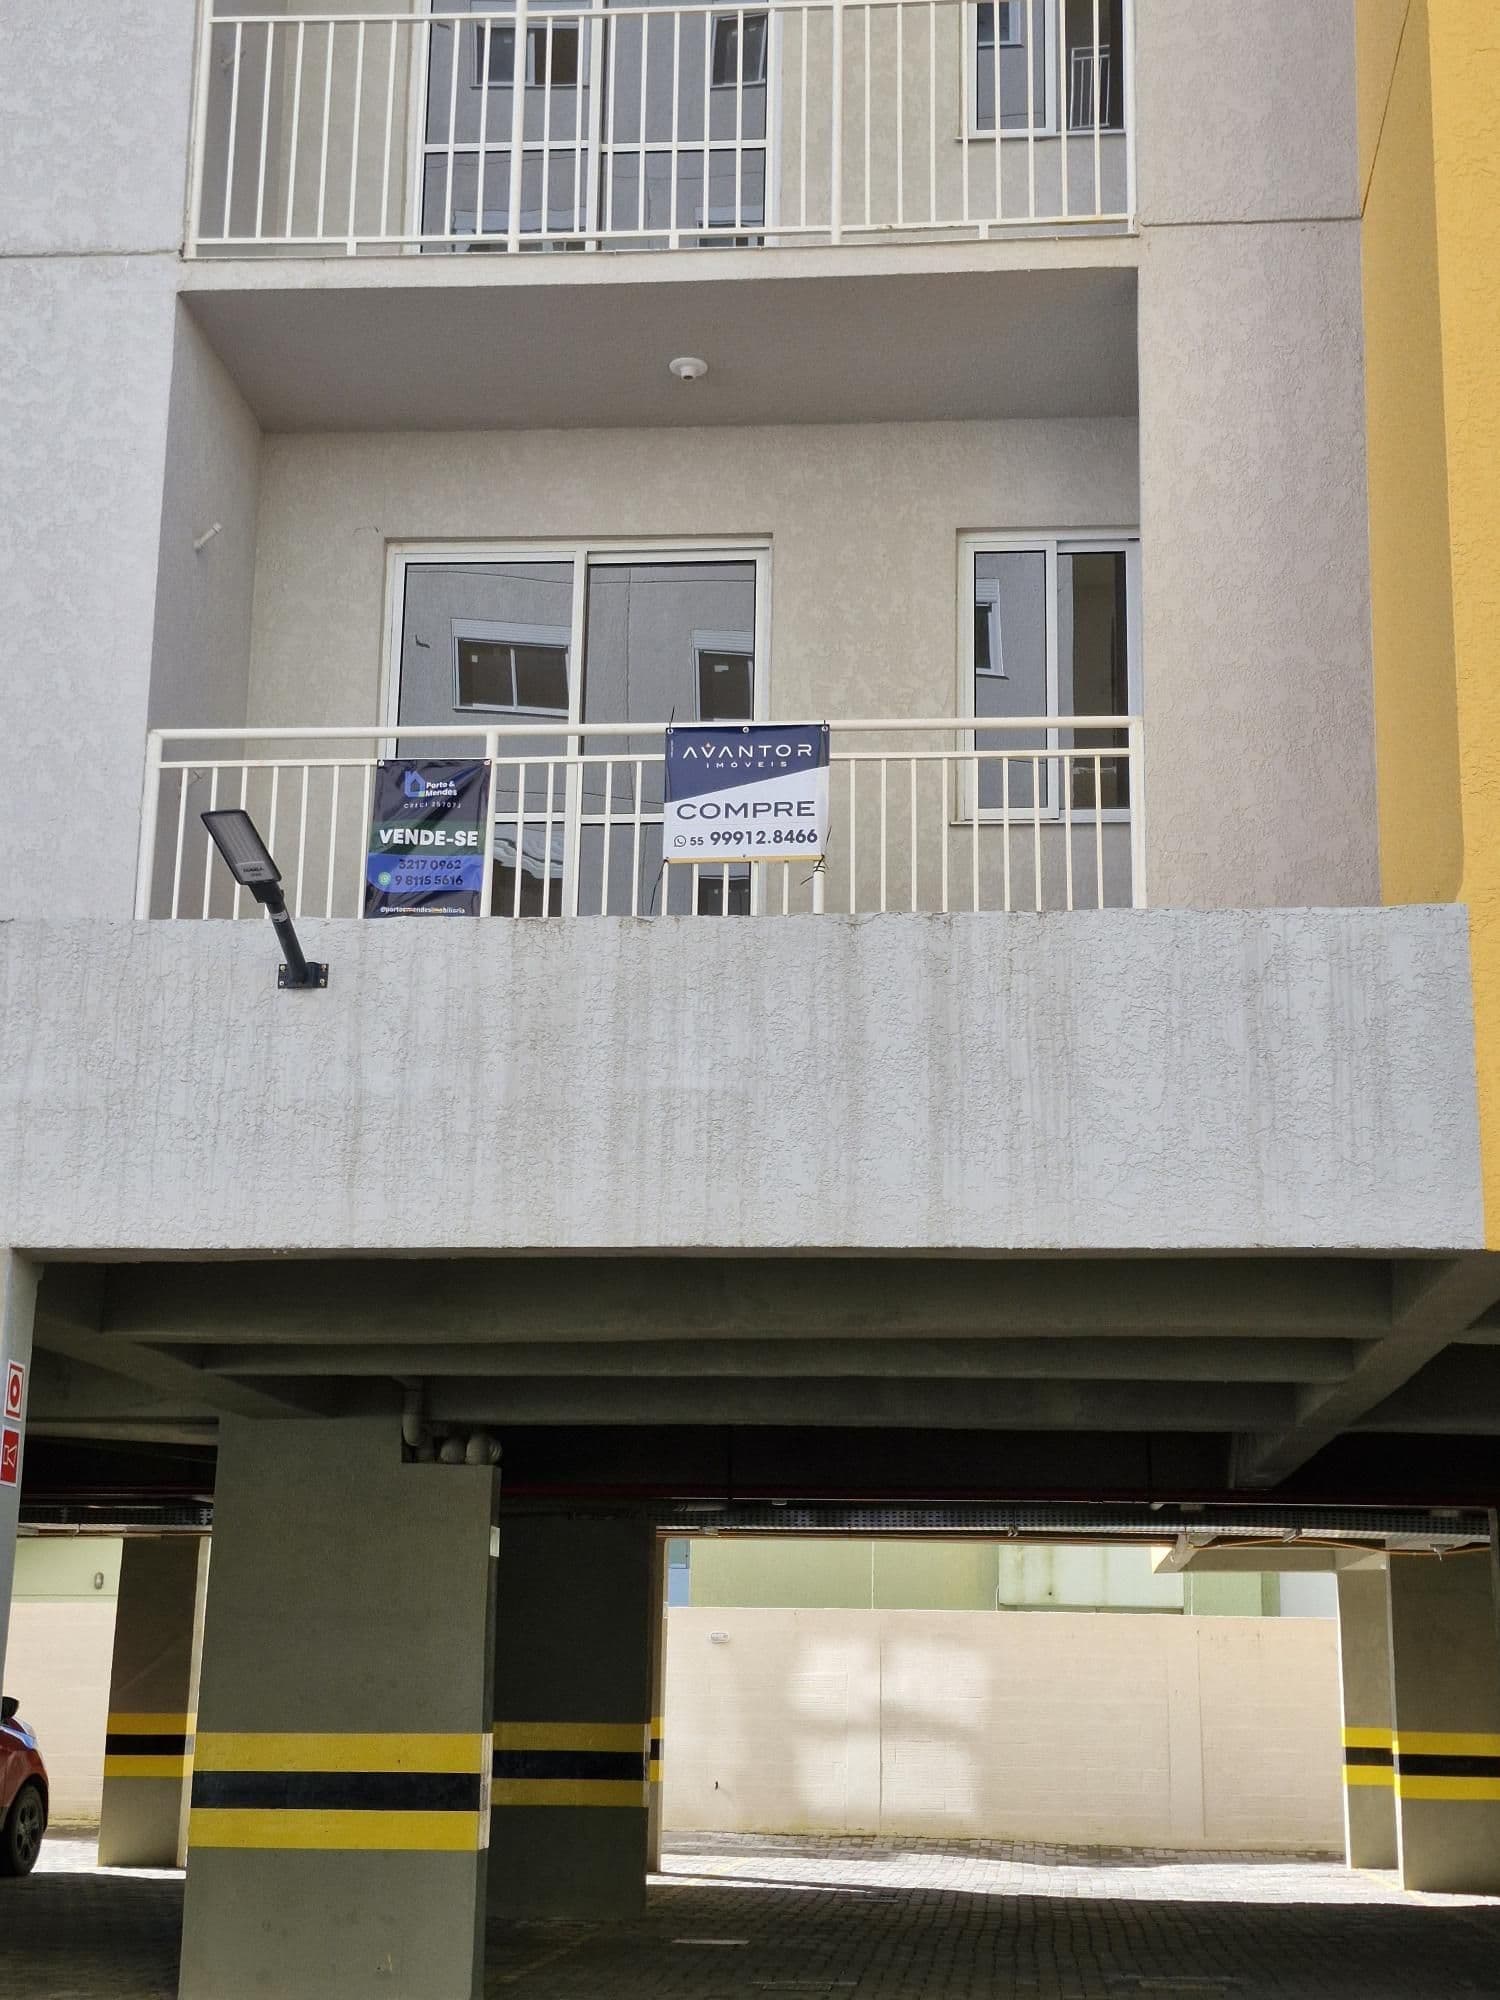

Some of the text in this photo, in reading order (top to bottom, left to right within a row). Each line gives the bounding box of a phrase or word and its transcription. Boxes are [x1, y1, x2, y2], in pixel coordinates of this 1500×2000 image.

[682, 742, 812, 759] AVANTOR
[426, 780, 456, 789] Porto &
[425, 789, 457, 797] Mendes
[676, 800, 816, 820] COMPRE
[379, 828, 479, 847] VENDE-SE
[690, 829, 818, 846] 55 99912.8466
[398, 859, 462, 870] 3217 0962
[395, 875, 464, 886] 9 8115 5616
